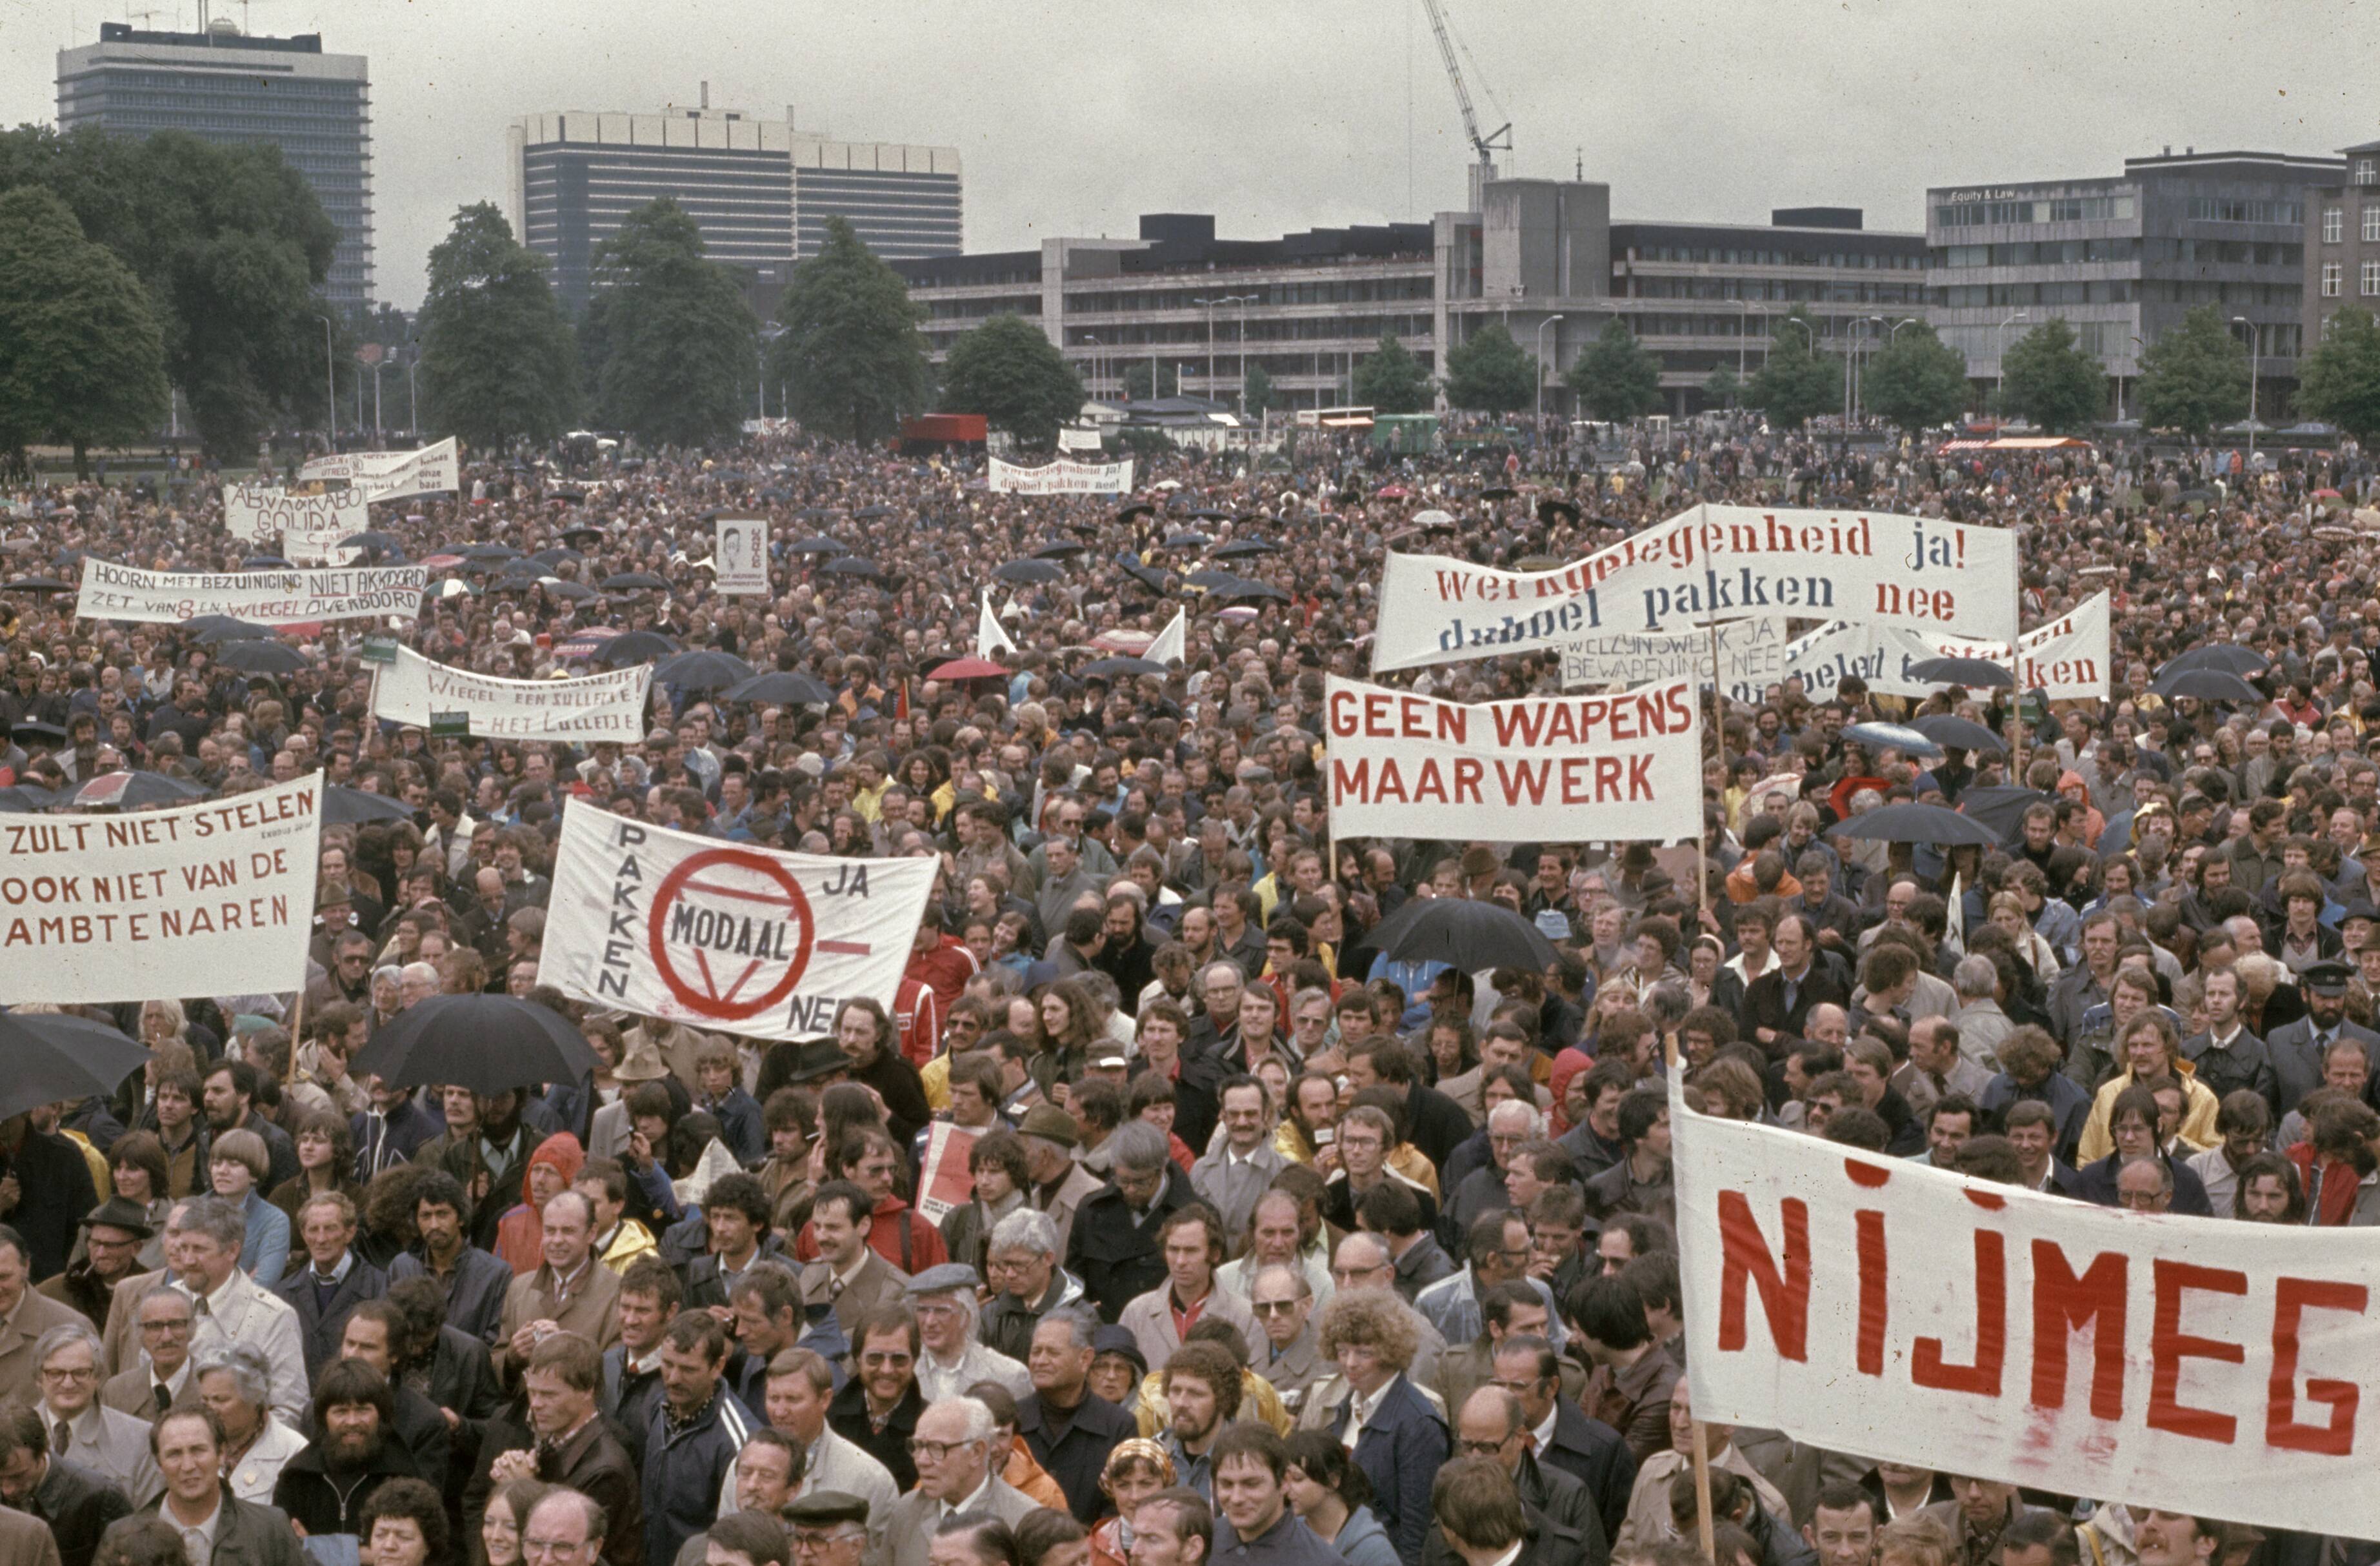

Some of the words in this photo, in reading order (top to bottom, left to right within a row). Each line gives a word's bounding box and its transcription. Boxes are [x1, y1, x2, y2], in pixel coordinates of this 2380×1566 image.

[1951, 191, 1983, 202] Equity
[1985, 190, 1991, 199] &
[1995, 189, 2015, 199] Law
[1912, 521, 1966, 572] ja!
[91, 591, 134, 608] ZET
[228, 600, 300, 617] WIEGEL
[306, 590, 416, 615] OVERBOORD
[95, 565, 155, 589] HOORN
[163, 576, 195, 588] MET
[202, 574, 301, 590] BEZUINIGING
[310, 572, 353, 594] NIET
[1643, 567, 1833, 628] pakken
[1875, 583, 1955, 621] nee
[1743, 617, 1774, 646] JA
[1732, 643, 1779, 676] NEE
[428, 673, 495, 703] WIEGEL
[515, 688, 545, 705] EEN
[492, 716, 531, 733] HET
[1330, 690, 1467, 744] GEEN
[1491, 683, 1692, 747] WAPENS
[1334, 758, 1484, 807] MAAR
[1495, 754, 1655, 806] WERK
[6, 823, 90, 854] ZULT
[106, 816, 180, 847] NIET
[195, 789, 314, 836] STELEN
[2, 876, 81, 905] OOK
[94, 870, 166, 902] NIET
[182, 859, 236, 891] VAN
[252, 848, 287, 879] DE
[823, 865, 869, 898] JA
[5, 894, 288, 947] AMBTENAREN
[597, 823, 646, 998] PAKKEN
[671, 903, 790, 961] MODAAL
